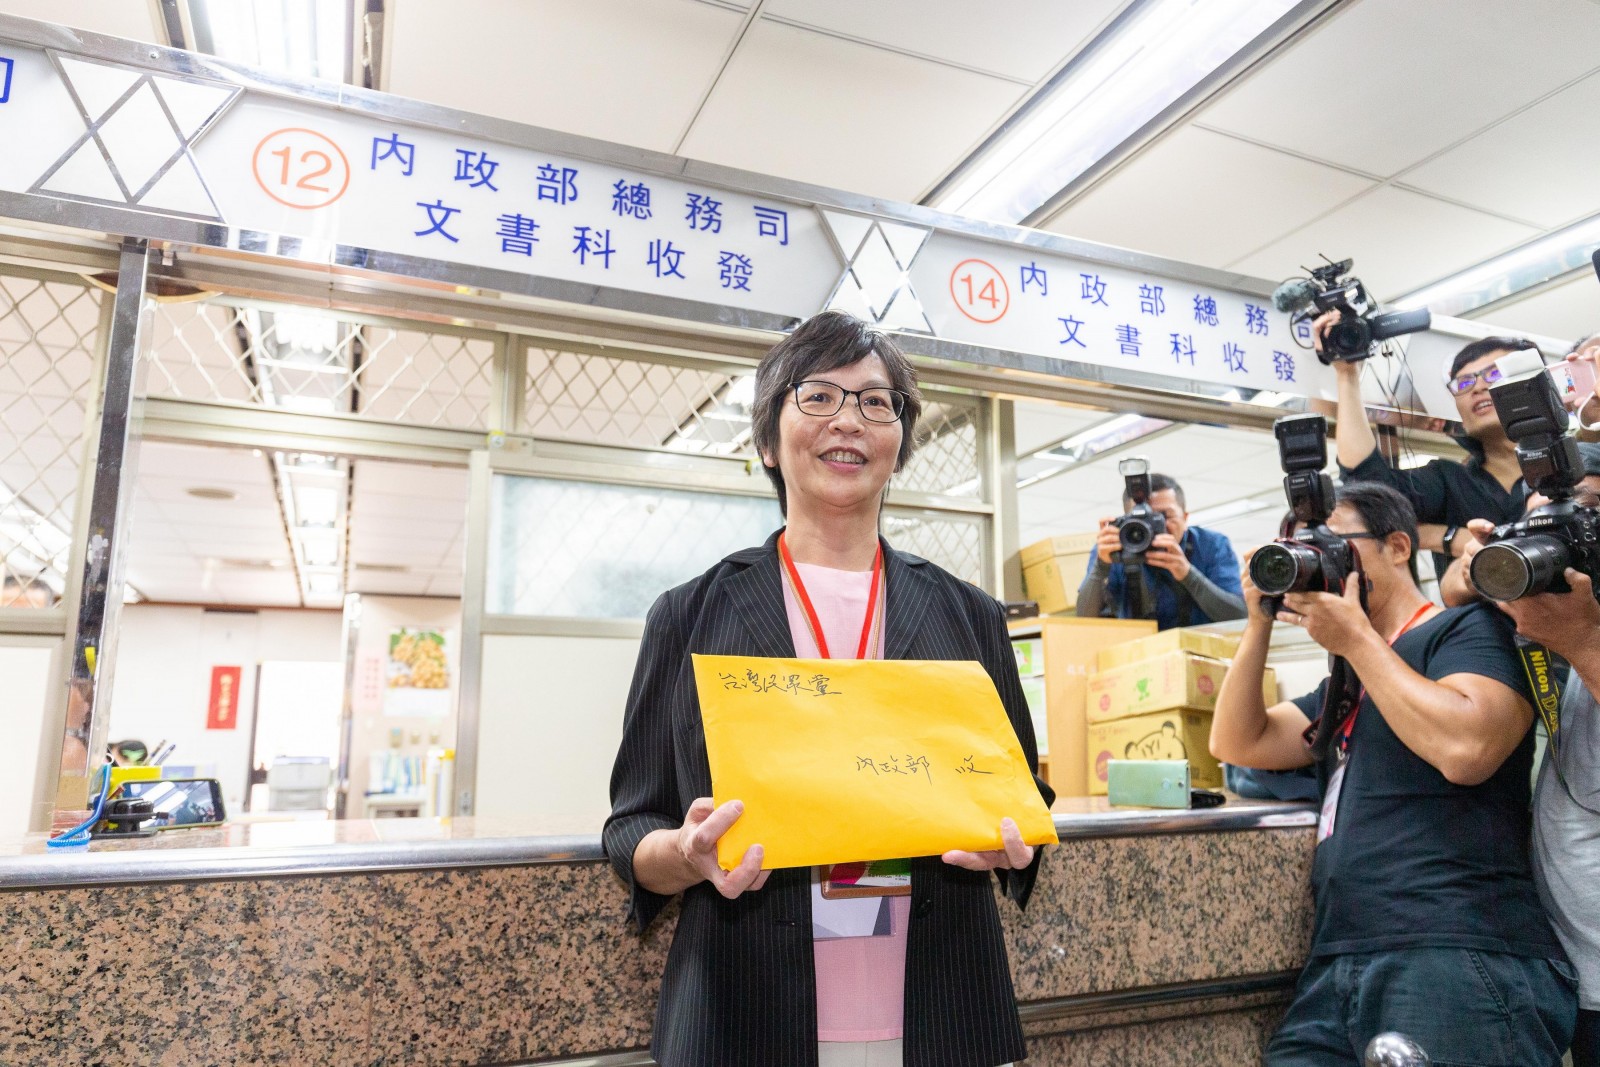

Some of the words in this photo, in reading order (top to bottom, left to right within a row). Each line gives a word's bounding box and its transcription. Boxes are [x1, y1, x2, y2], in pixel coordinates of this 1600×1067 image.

[271, 145, 333, 193] 12
[415, 200, 752, 291] 文書科收發
[960, 273, 1000, 309] 14
[1058, 315, 1296, 383] 文書科收發
[1529, 518, 1553, 526] Nikon
[1529, 651, 1549, 693] Nikon
